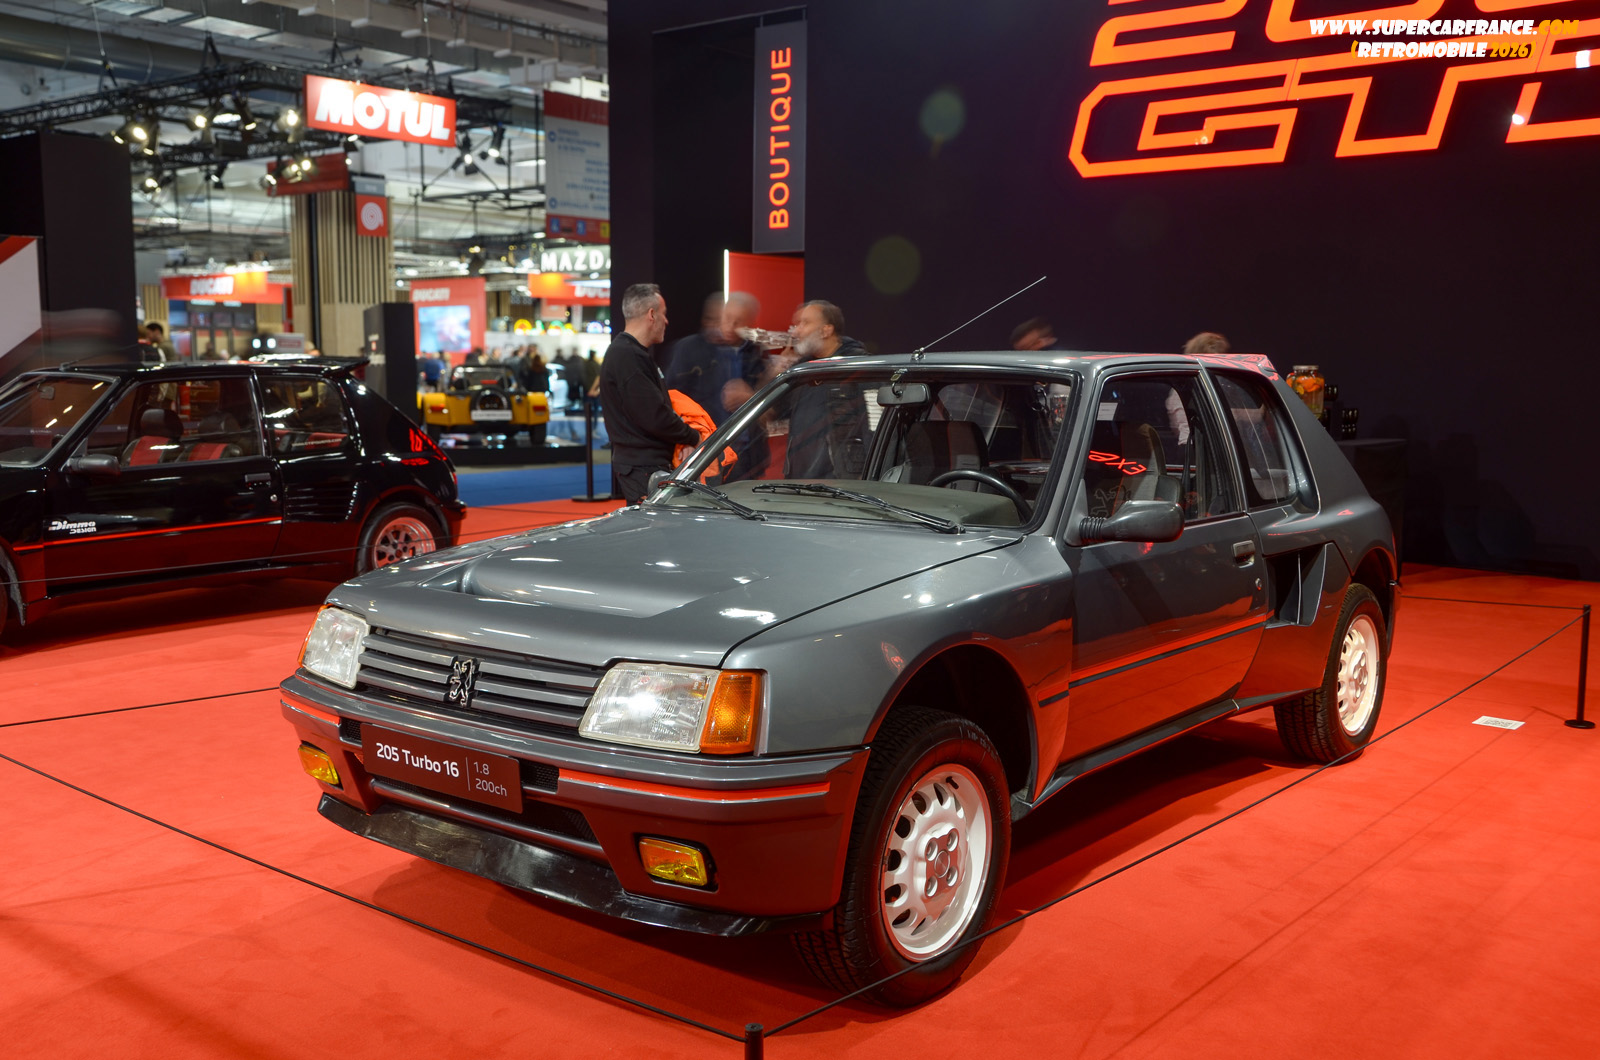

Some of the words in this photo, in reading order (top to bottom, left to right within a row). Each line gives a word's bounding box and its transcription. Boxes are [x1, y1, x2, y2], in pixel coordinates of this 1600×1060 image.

[315, 84, 451, 141] MOTUL
[768, 47, 792, 229] BOUTIQUE
[48, 520, 96, 531] Dimma
[376, 742, 400, 762] 205
[402, 749, 441, 774] Turbo
[443, 760, 460, 778] 16
[473, 761, 490, 776] 1.8
[475, 778, 508, 797] 200ch
